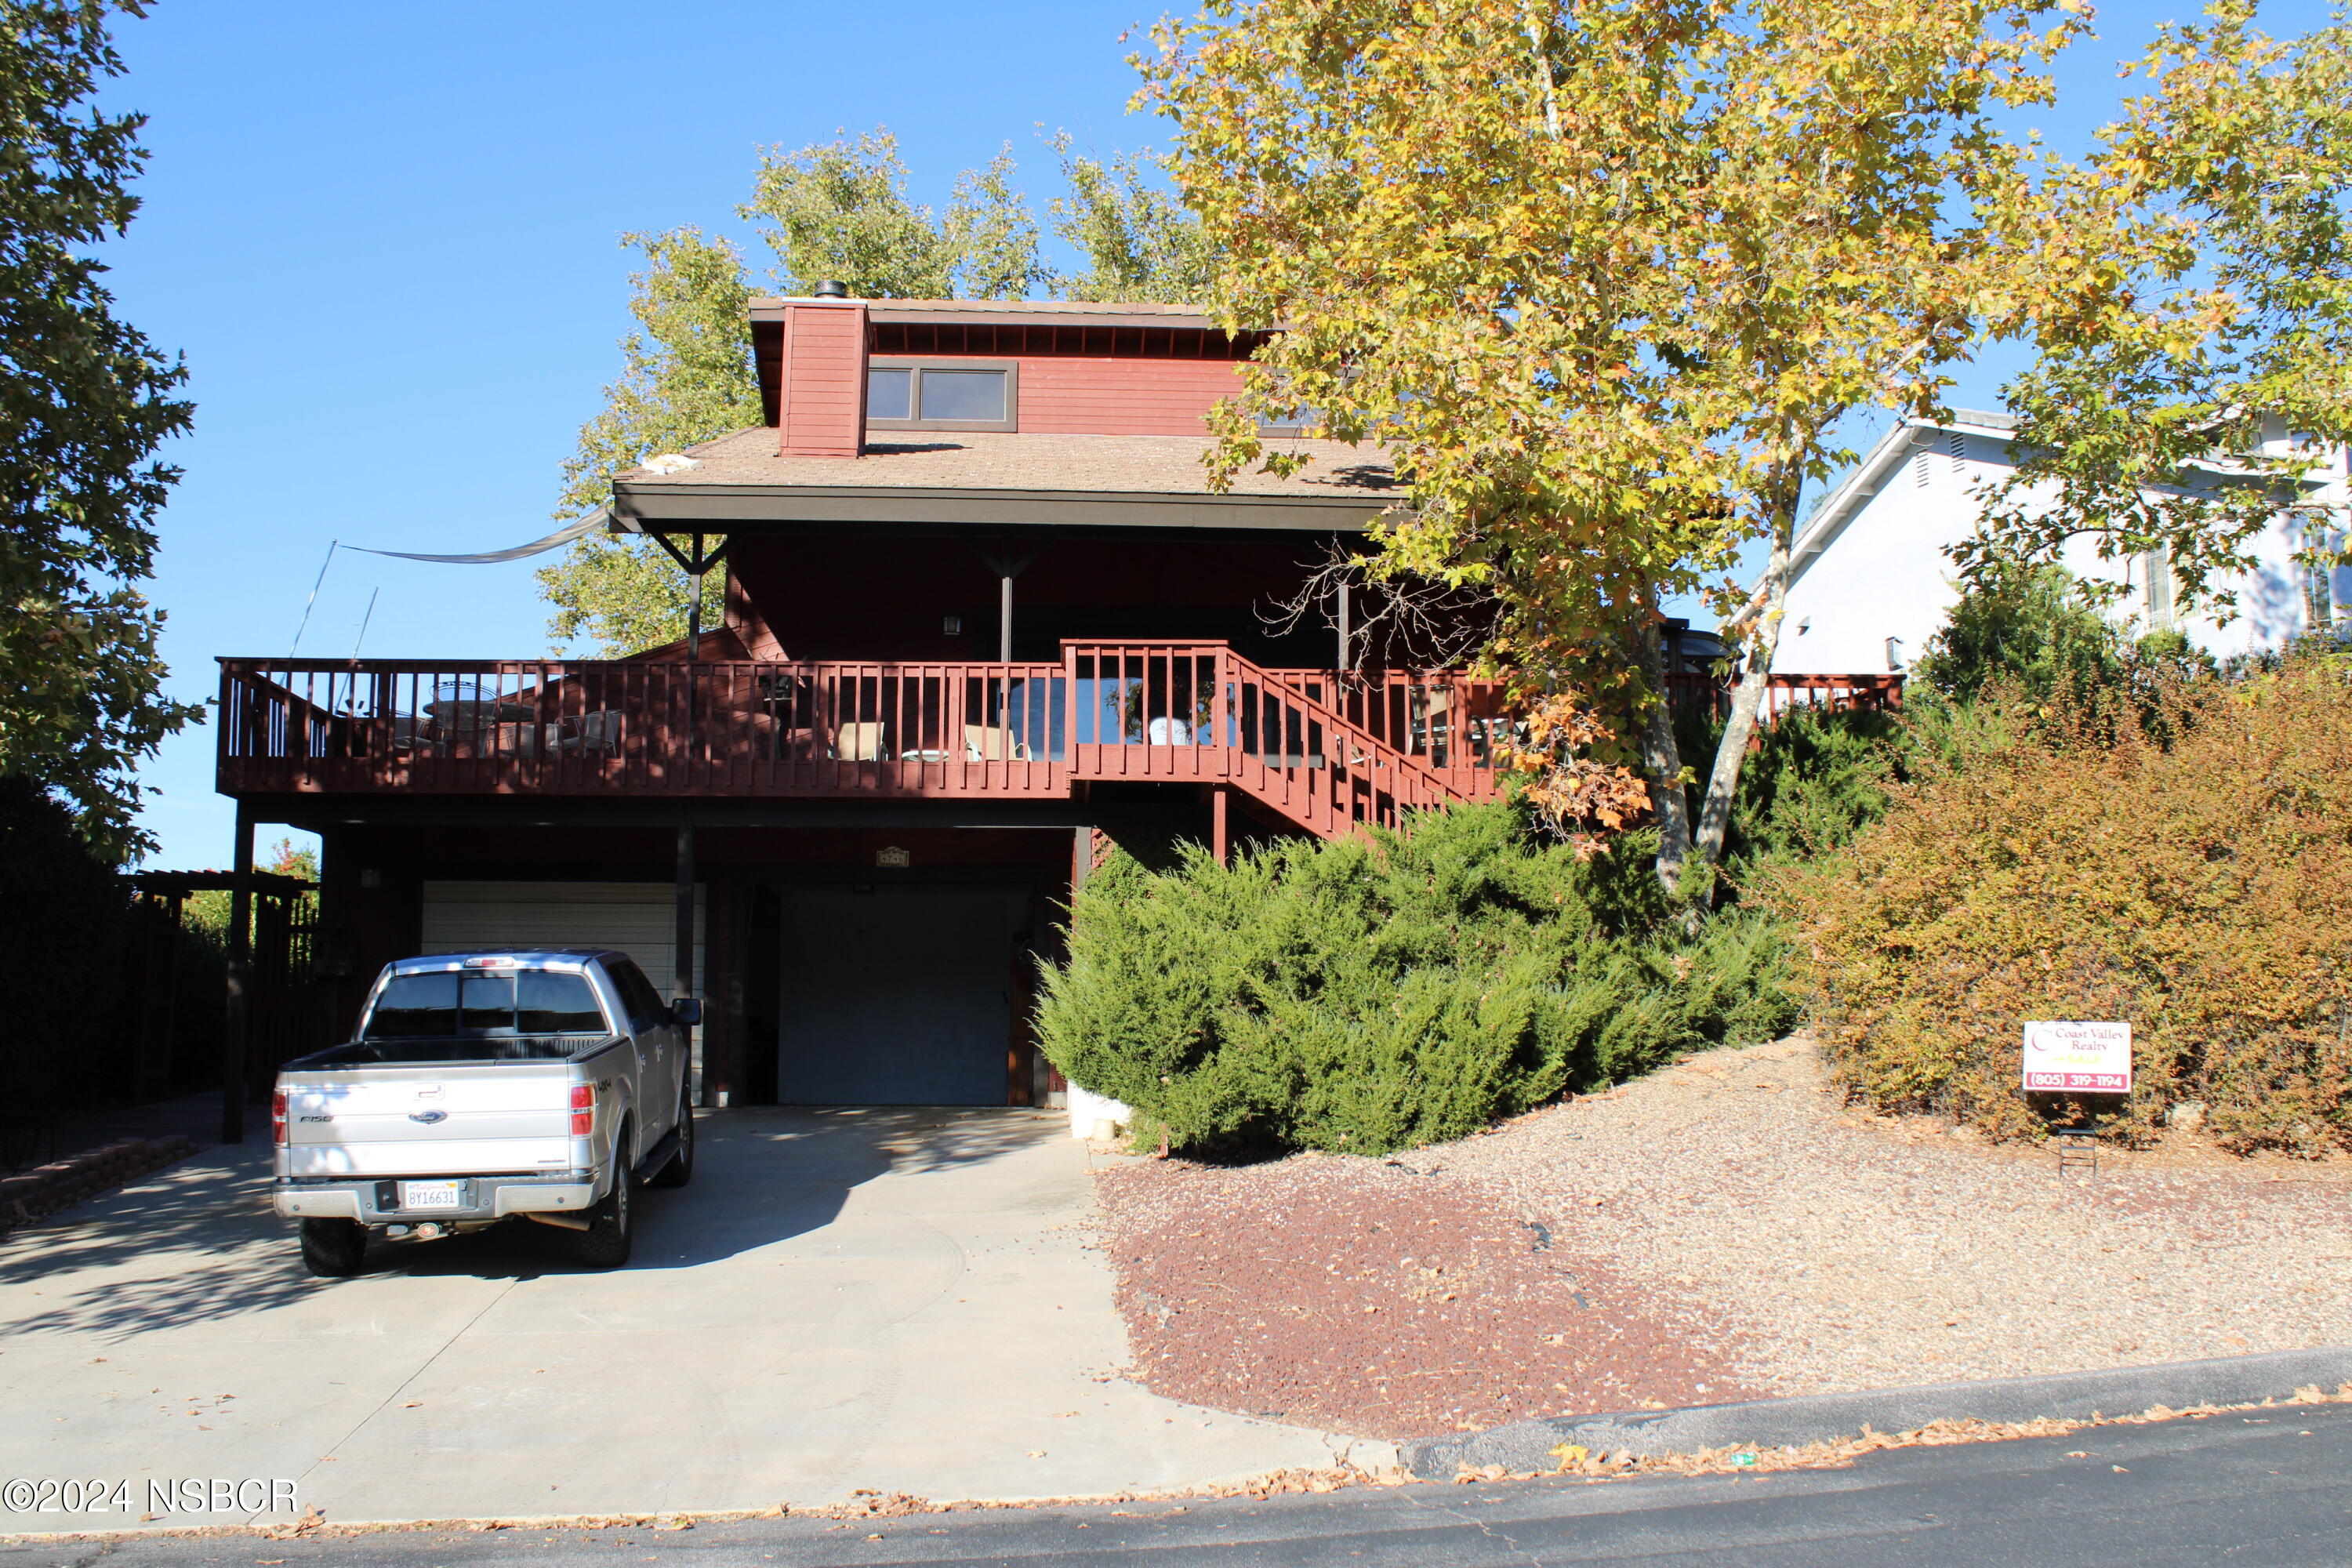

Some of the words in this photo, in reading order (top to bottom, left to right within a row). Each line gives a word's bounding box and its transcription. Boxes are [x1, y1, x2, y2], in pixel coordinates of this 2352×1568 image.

[2056, 1028, 2088, 1039] Coast
[2091, 1029, 2125, 1040] Valley
[2072, 1040, 2108, 1051] Realty
[2067, 1054, 2102, 1065] SALE
[2031, 1073, 2065, 1087] (805)
[2070, 1075, 2123, 1087] 319-1194
[408, 1191, 456, 1205] 8Y16631
